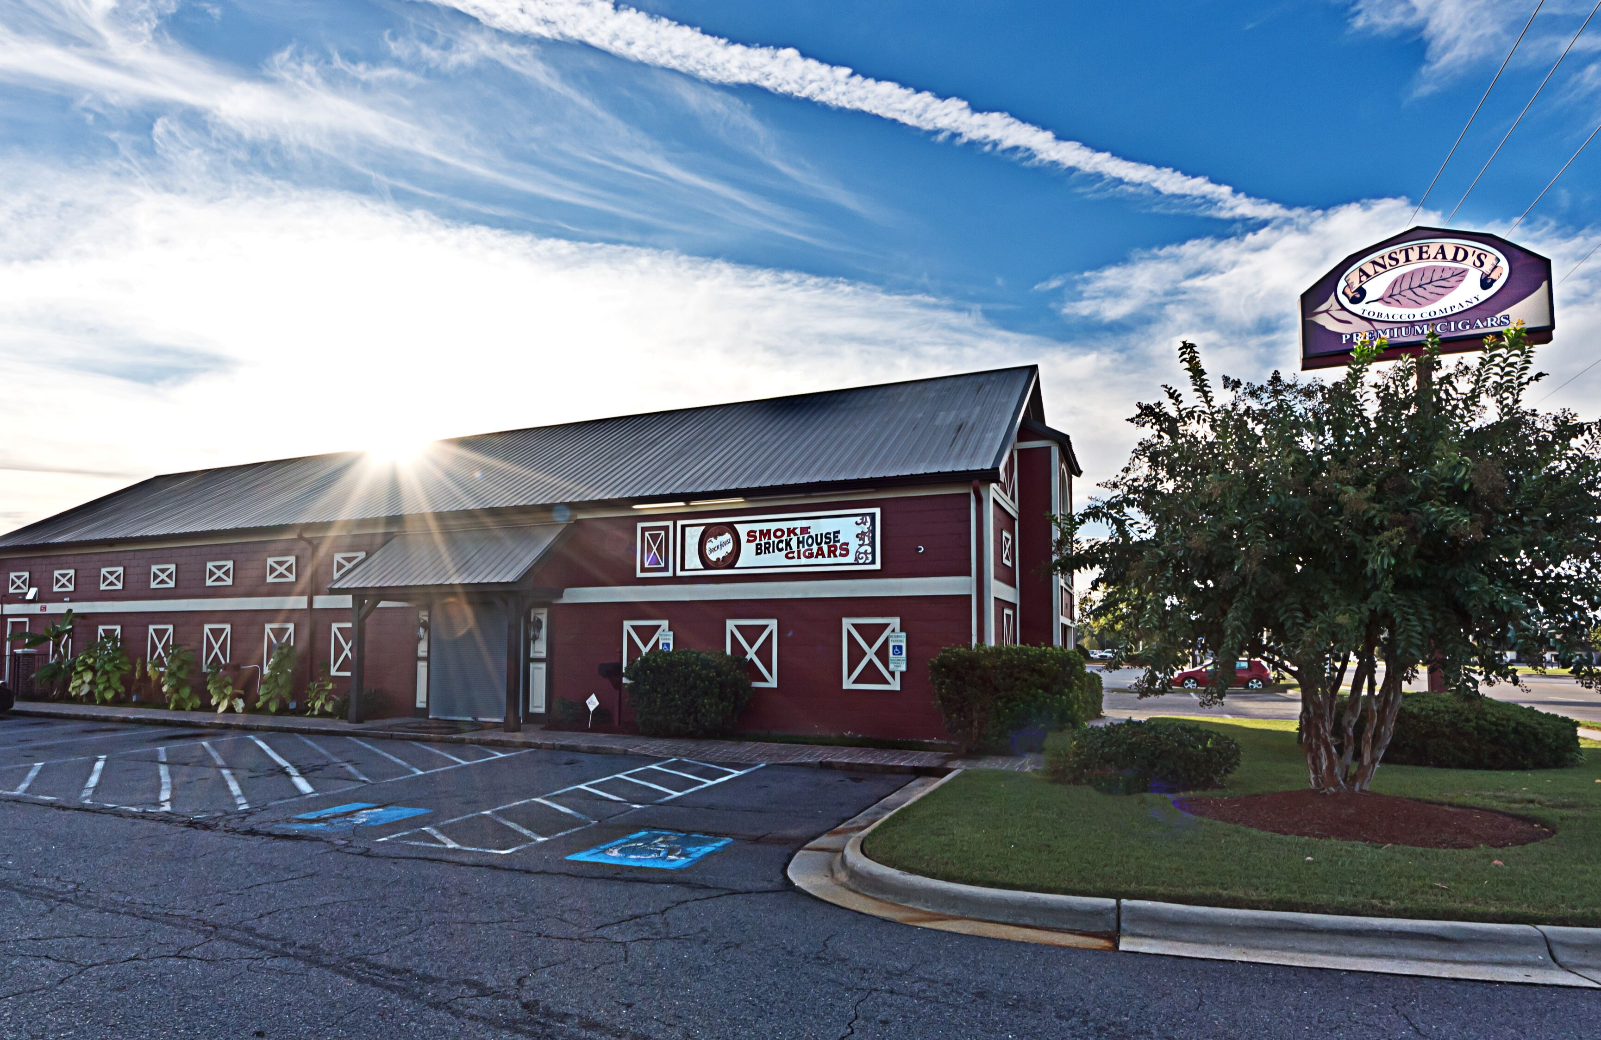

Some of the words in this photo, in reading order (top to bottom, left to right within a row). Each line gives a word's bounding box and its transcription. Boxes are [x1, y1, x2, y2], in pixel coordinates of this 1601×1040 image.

[1357, 244, 1487, 284] ANSTEAD'S
[1361, 308, 1416, 320] TOBACCO
[1420, 294, 1481, 319] COMPANY
[1341, 323, 1429, 344] PREMIUM
[1436, 314, 1510, 333] CIGARS
[746, 526, 811, 543] SMOKE
[755, 538, 793, 556] BRICK
[797, 530, 840, 549] HOUSE
[785, 542, 850, 560] CIGARS
